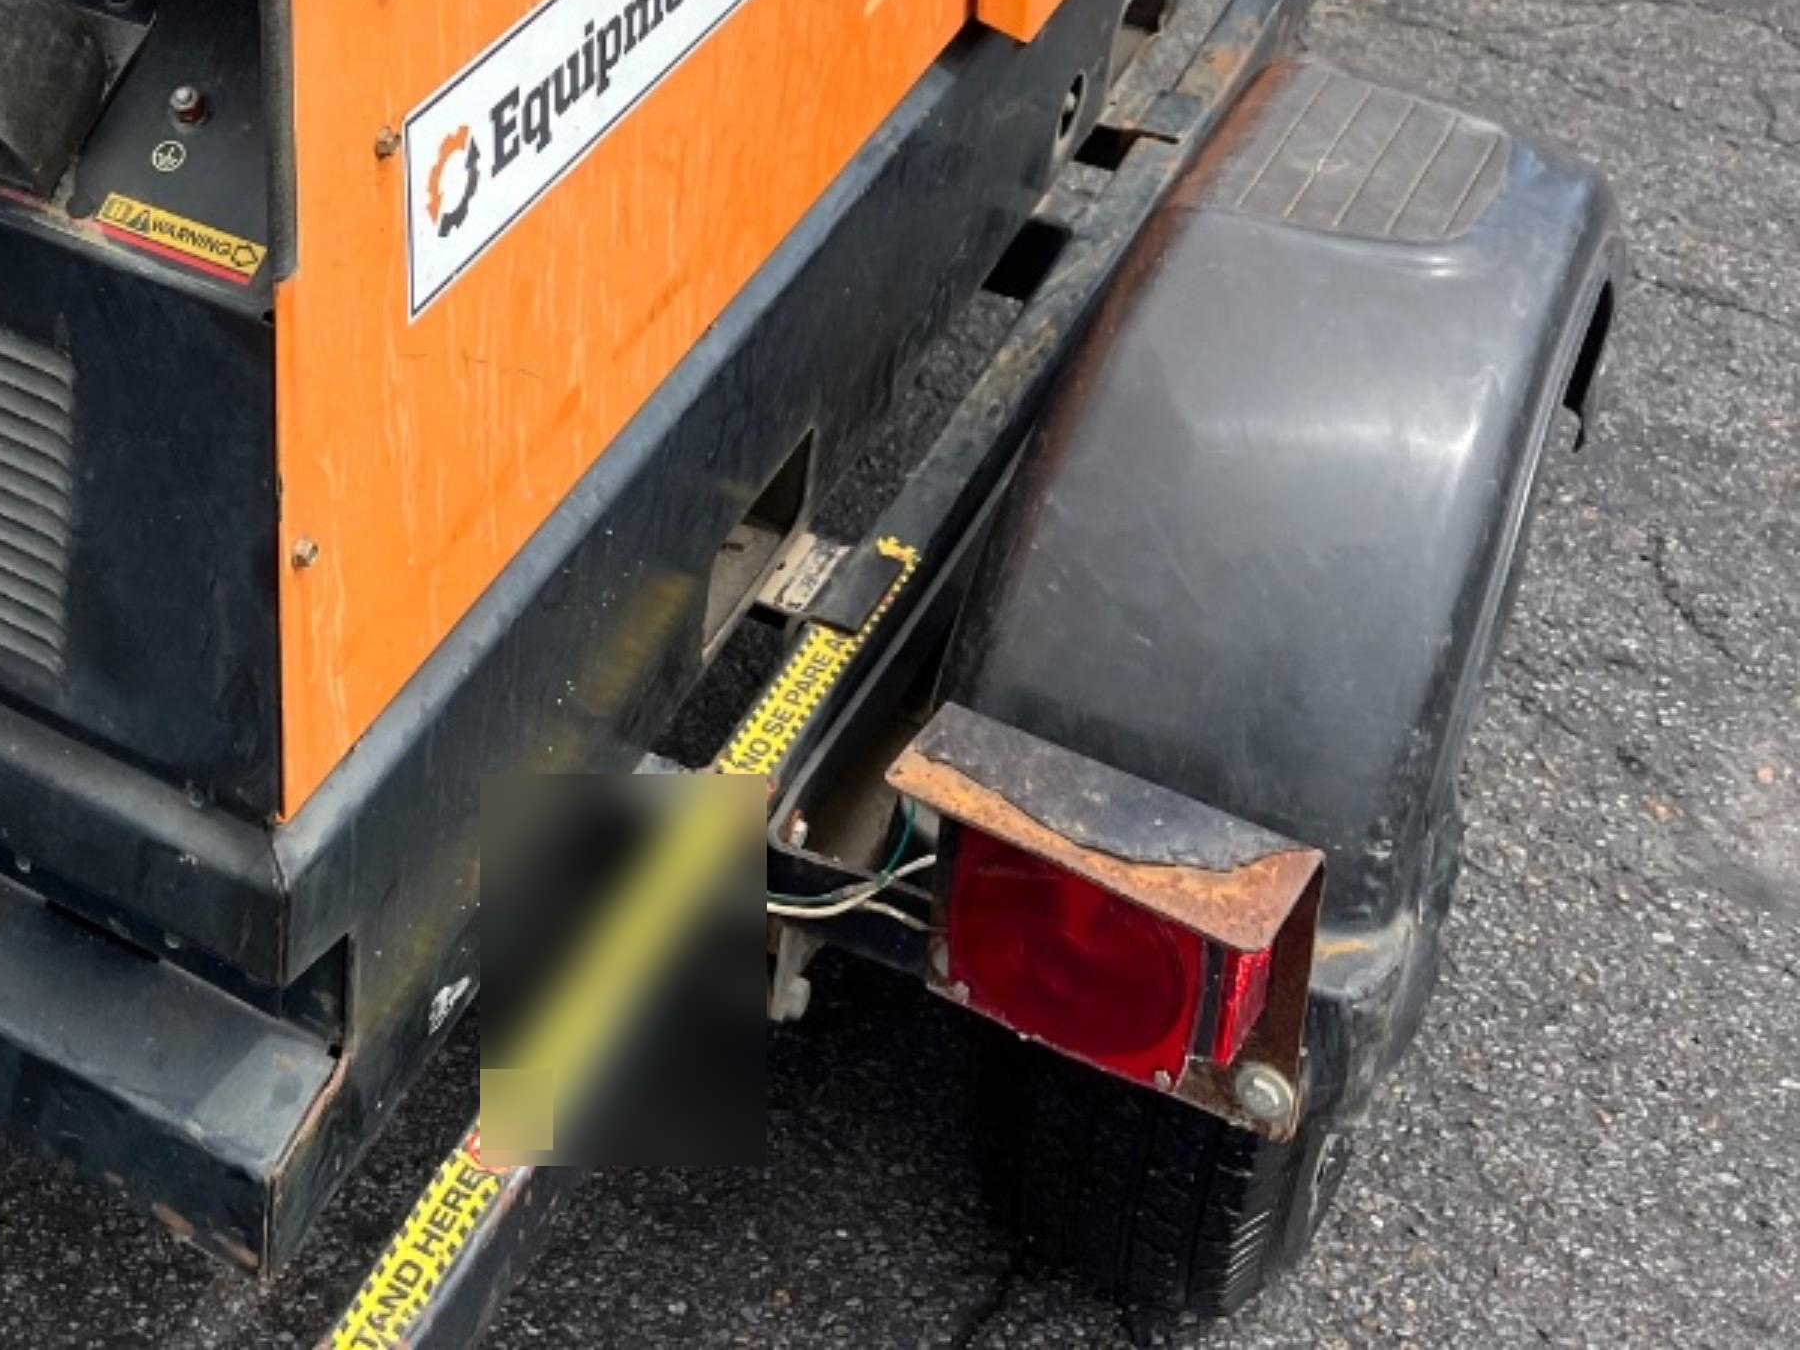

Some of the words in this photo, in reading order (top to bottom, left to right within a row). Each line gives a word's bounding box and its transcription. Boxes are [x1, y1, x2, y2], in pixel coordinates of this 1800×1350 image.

[151, 217, 234, 259] WARNING
[735, 738, 773, 771] NO
[762, 708, 796, 737] SE
[783, 652, 835, 706] PARE
[420, 1163, 486, 1262] HERE
